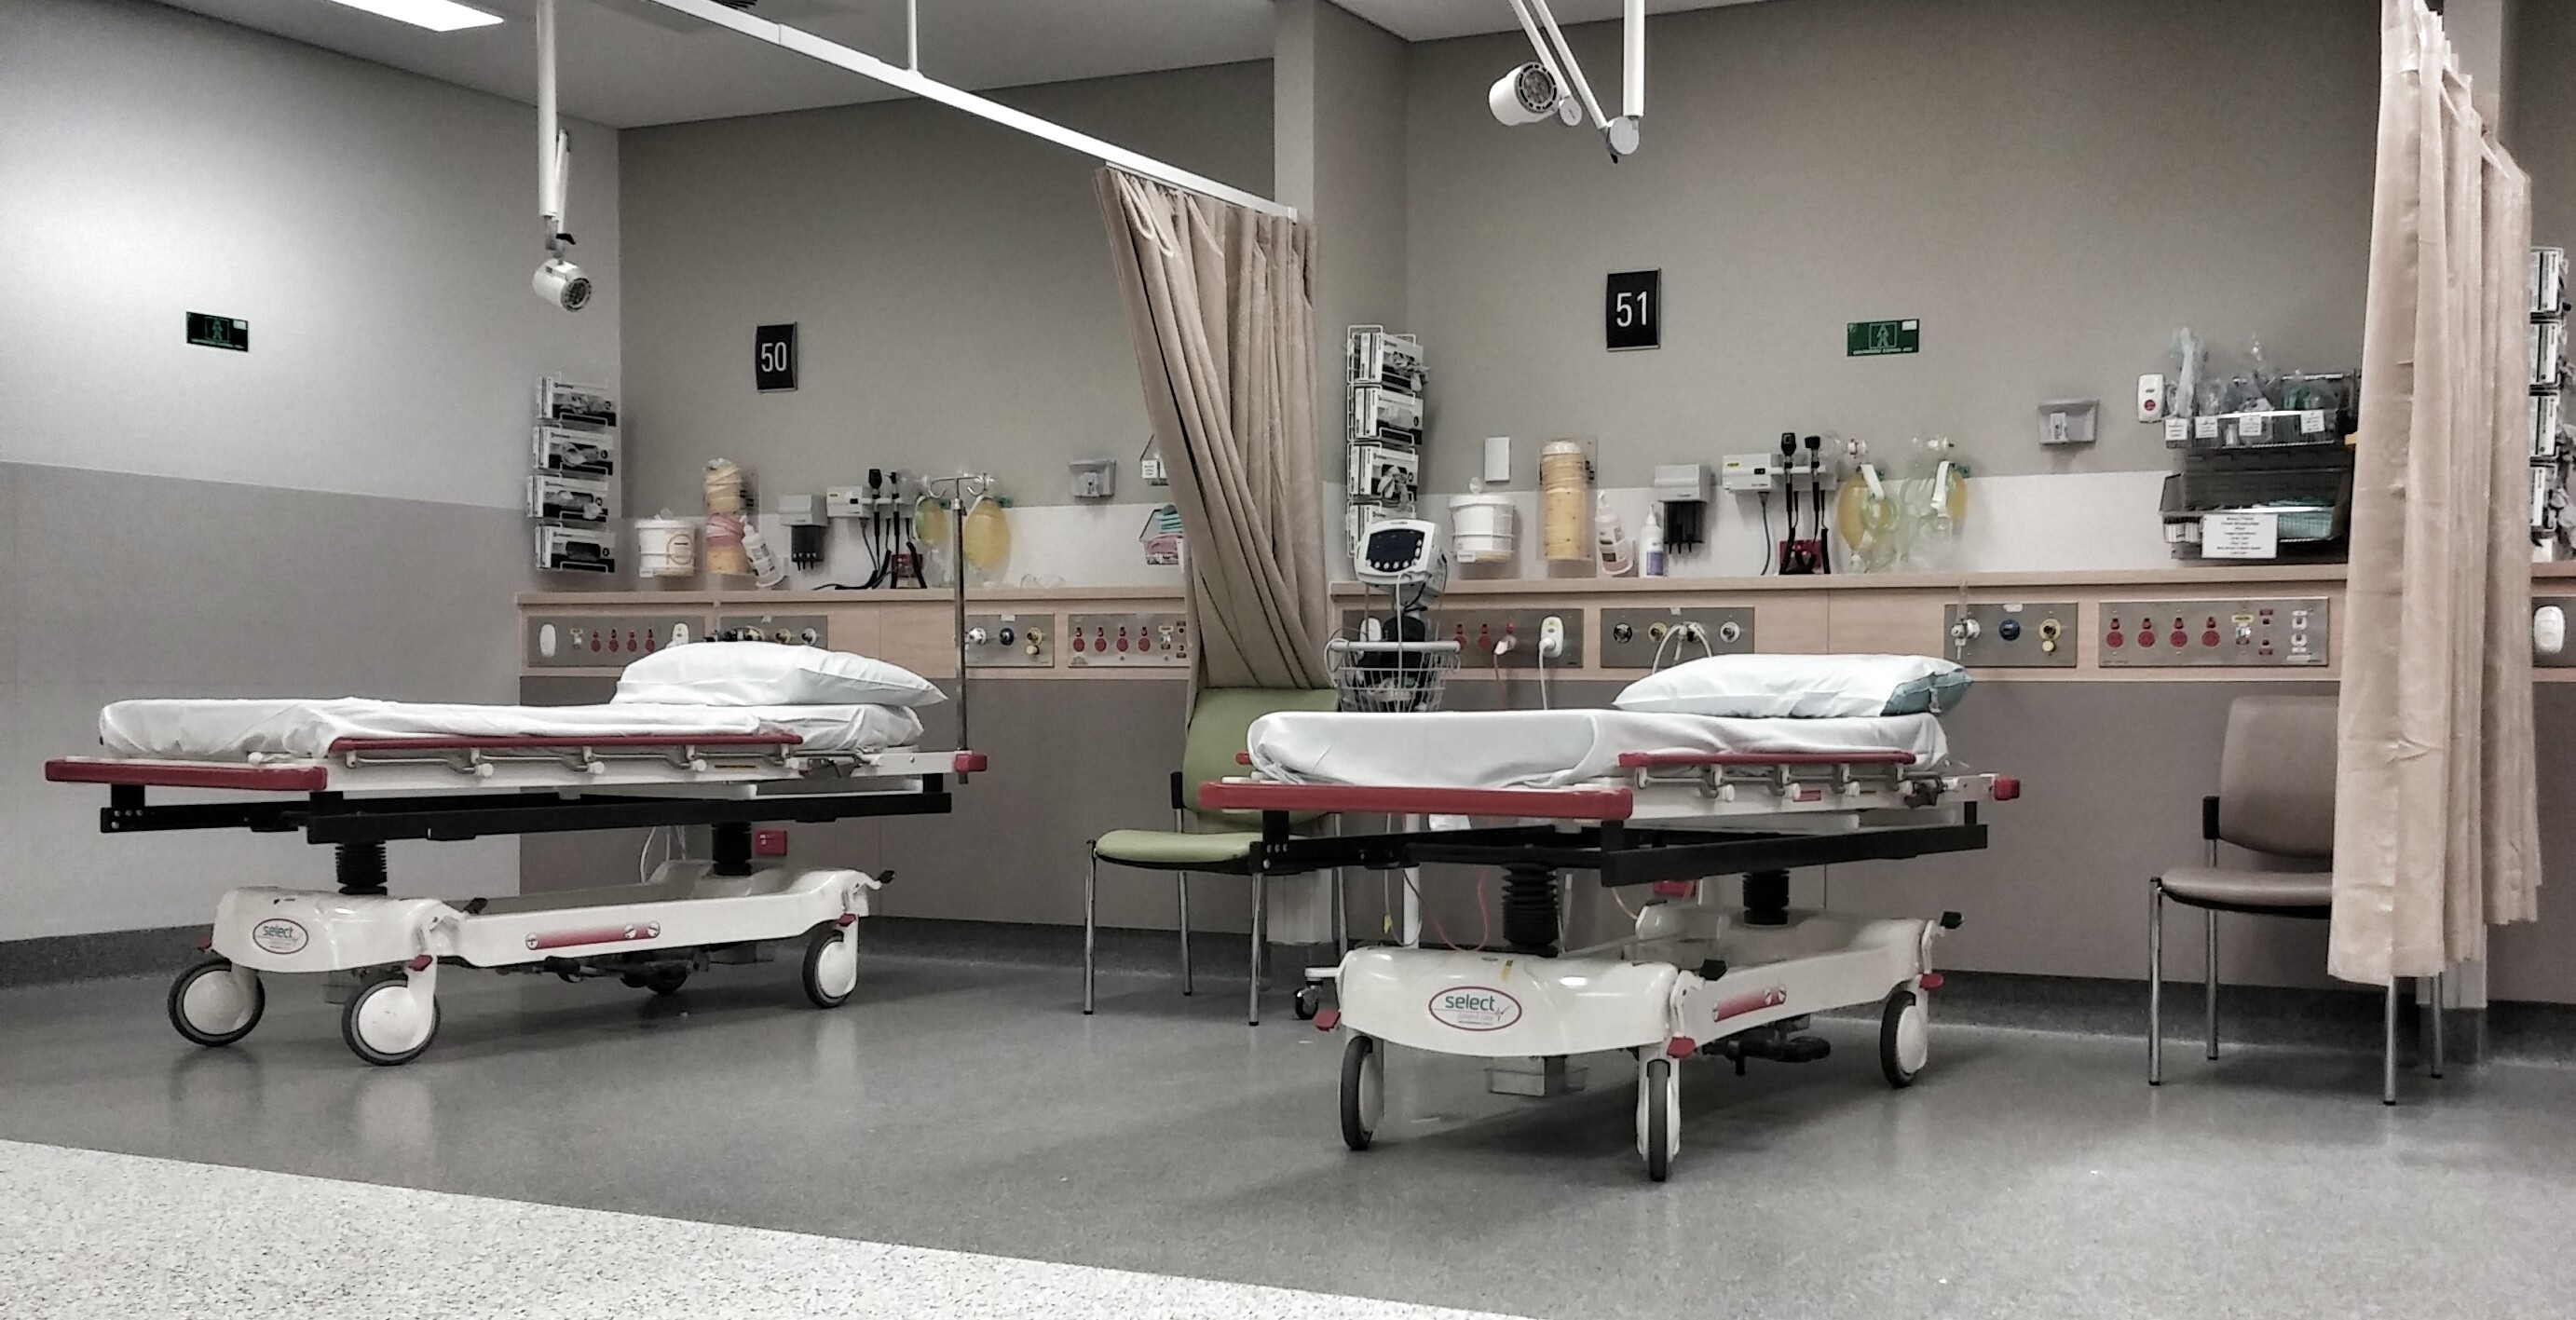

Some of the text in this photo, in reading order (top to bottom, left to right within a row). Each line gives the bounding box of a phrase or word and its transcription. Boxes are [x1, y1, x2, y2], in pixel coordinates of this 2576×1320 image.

[1615, 291, 1647, 327] 51
[760, 341, 787, 373] 50
[263, 924, 293, 938] select
[1444, 993, 1495, 1012] select
